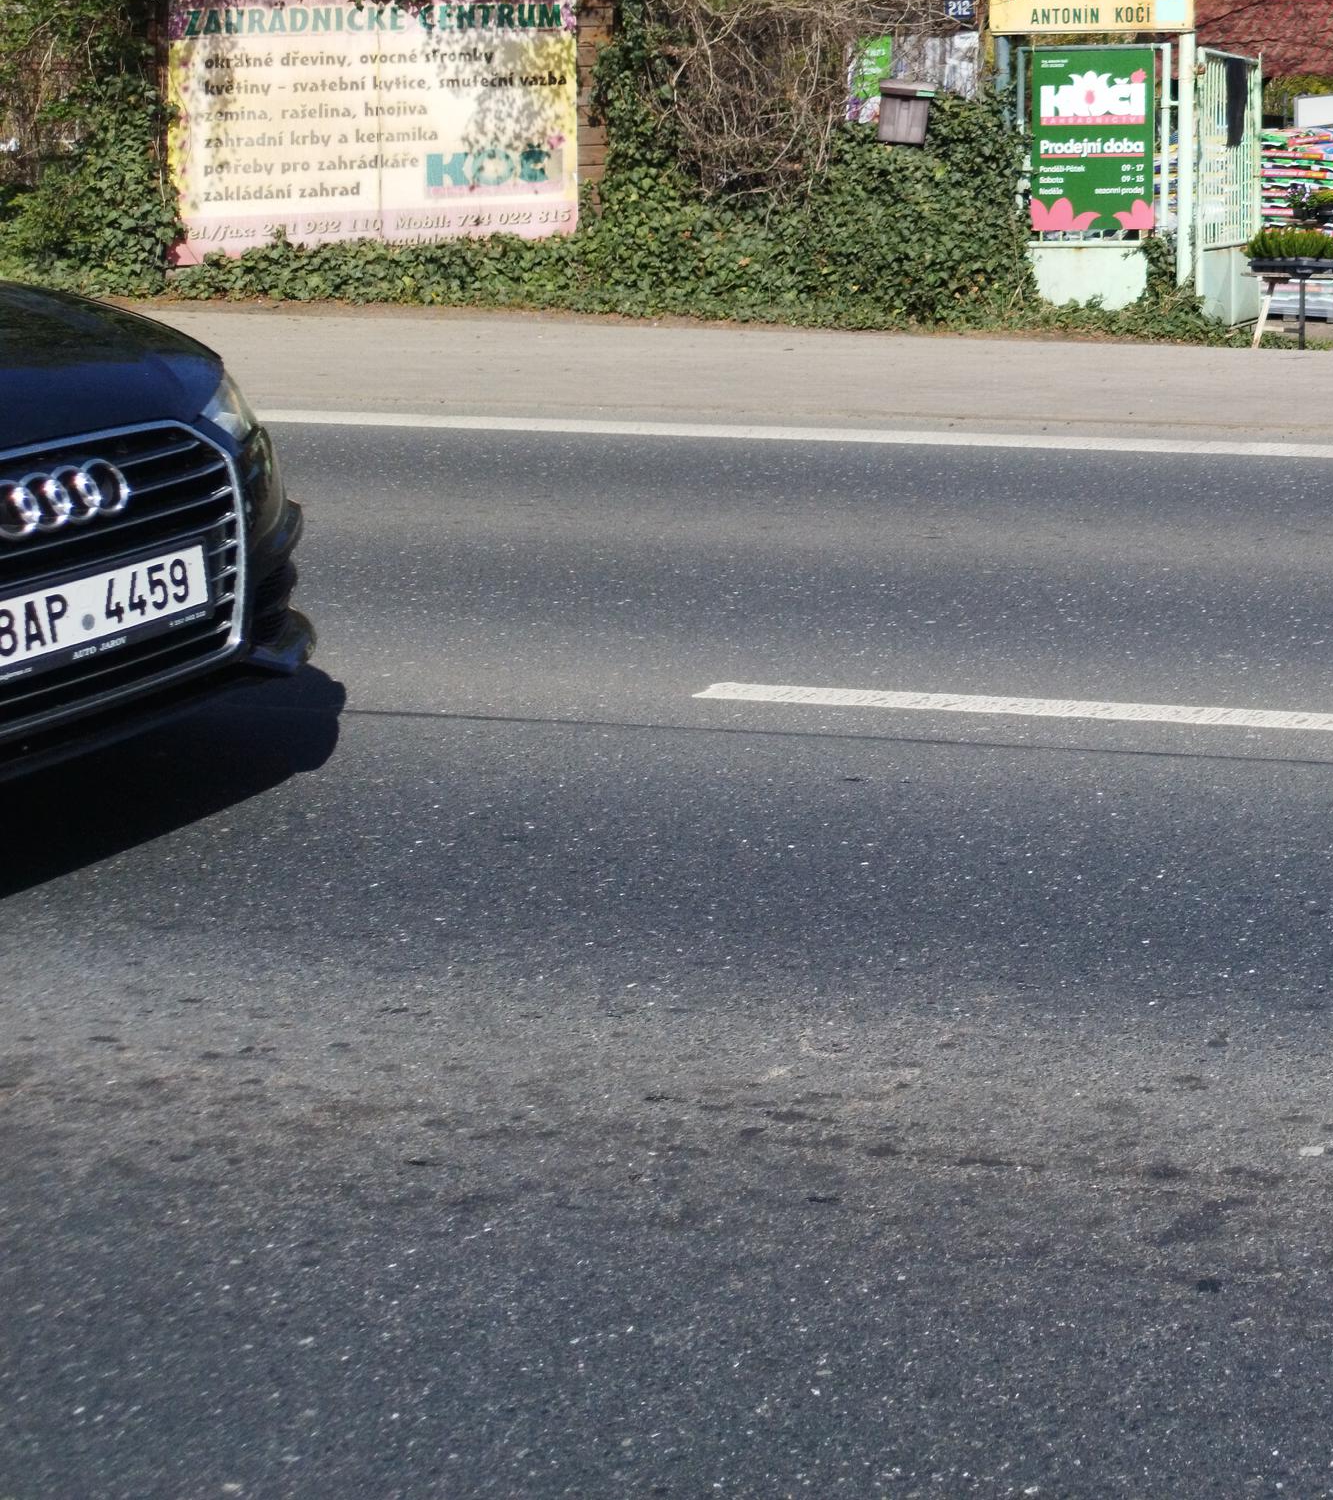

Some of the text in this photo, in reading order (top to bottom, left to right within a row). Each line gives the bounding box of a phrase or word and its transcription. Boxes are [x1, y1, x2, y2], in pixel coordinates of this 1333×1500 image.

[418, 2, 563, 30] CENTRUM
[947, 0, 972, 16] 212
[1030, 2, 1151, 25] ANTONÍN KOČÍ
[280, 51, 352, 69] dřeviny,
[359, 47, 418, 66] ovocné
[424, 47, 495, 65] stromky
[204, 78, 271, 96] květiny
[292, 74, 366, 93] svatební
[373, 75, 432, 92] kytice,
[439, 72, 514, 88] smuteční
[519, 71, 568, 87] vazba
[203, 102, 428, 123] zemina, rašelina, hnojiva
[203, 126, 439, 150] zahradní krby a keramika
[1039, 137, 1145, 158] Prodejní doba
[202, 153, 420, 177] potřeby pro zahrádkáře
[202, 181, 361, 203] zakládání zahrad
[456, 212, 492, 228] 724
[498, 211, 533, 226] 022
[538, 208, 573, 224] 815
[0, 558, 190, 658] 8AP 4459
[72, 645, 98, 661] AUTO
